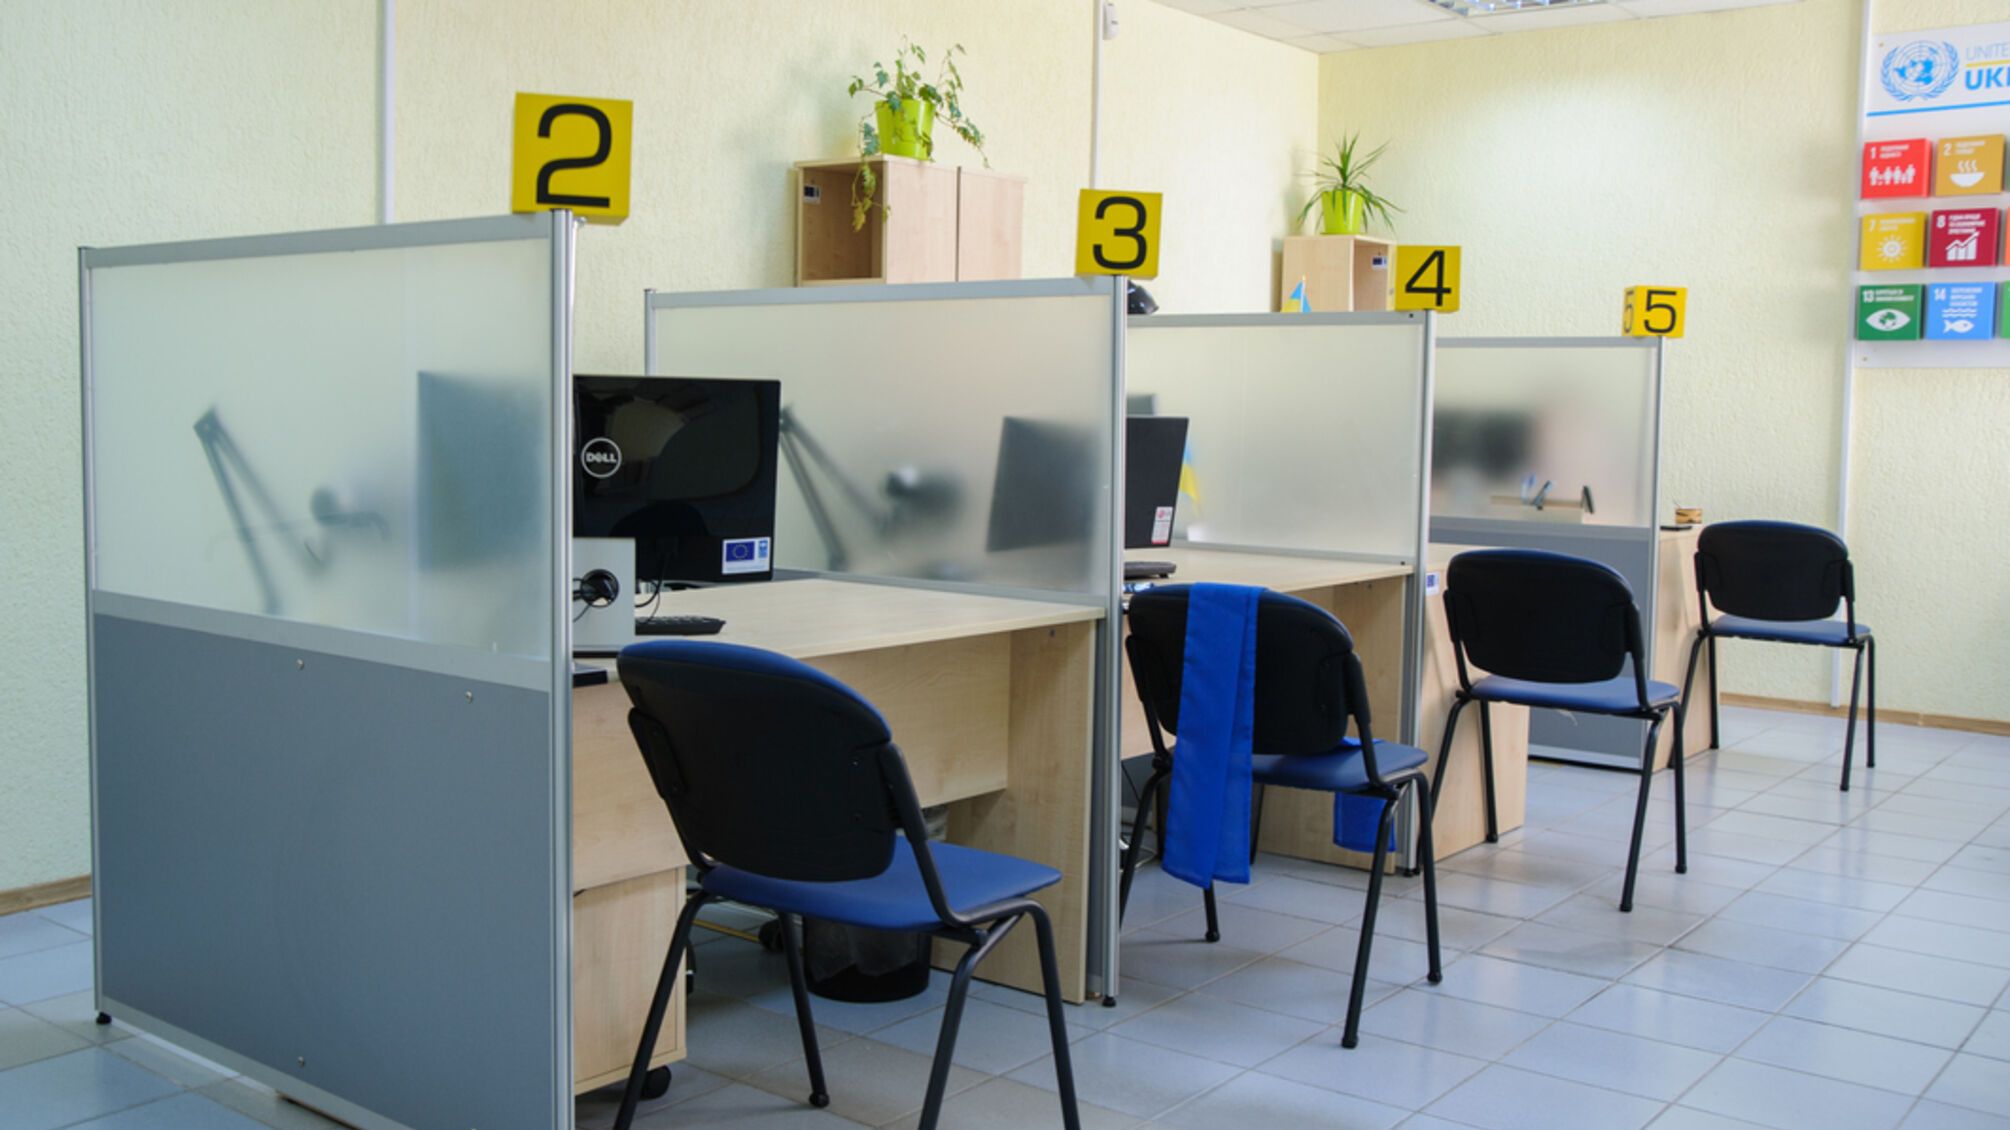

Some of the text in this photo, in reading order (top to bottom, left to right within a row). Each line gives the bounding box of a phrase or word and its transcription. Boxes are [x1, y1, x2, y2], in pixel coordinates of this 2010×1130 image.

[536, 103, 612, 208] 2
[1870, 146, 1877, 159] 1
[1943, 143, 1952, 156] 2
[1093, 196, 1147, 270] 3
[1405, 250, 1452, 307] 4
[1644, 289, 1676, 333] 5
[585, 452, 617, 463] DELL
